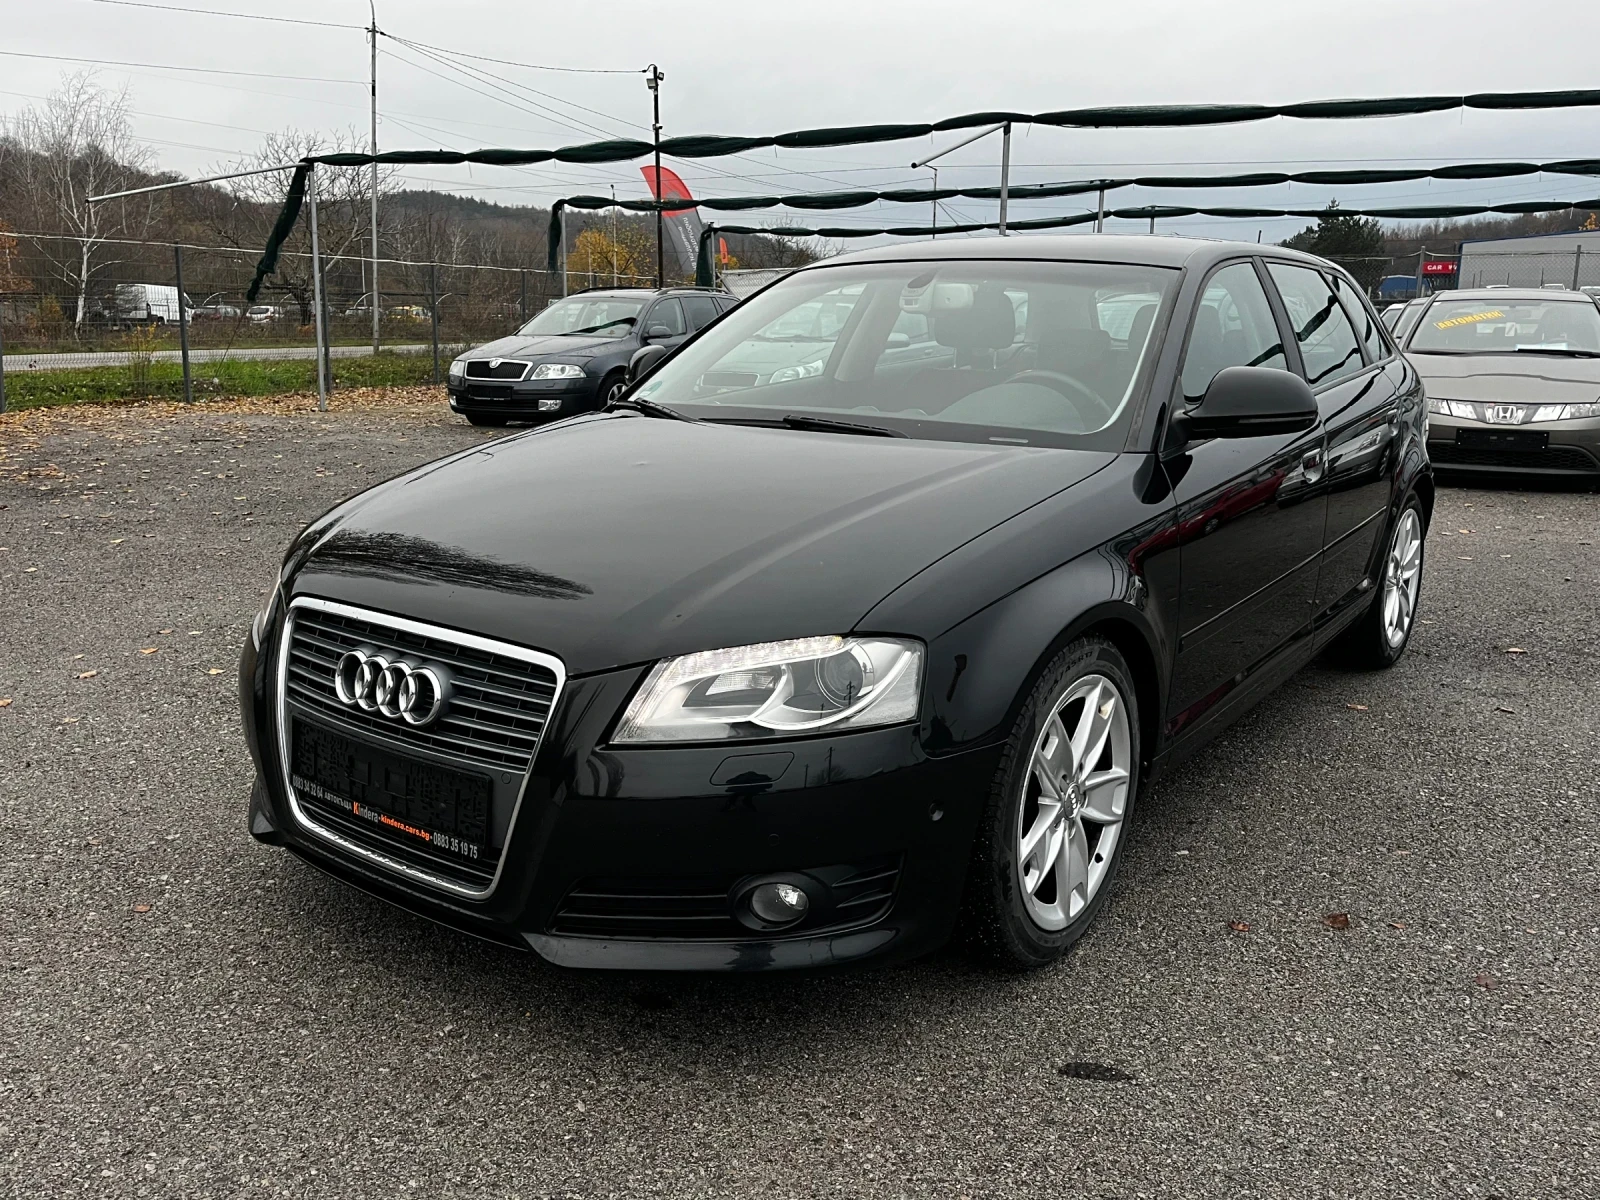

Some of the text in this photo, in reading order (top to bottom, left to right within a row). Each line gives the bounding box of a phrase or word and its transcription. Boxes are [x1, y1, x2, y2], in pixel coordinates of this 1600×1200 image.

[353, 801, 378, 822] Kindera
[433, 832, 449, 849] 0883
[450, 838, 459, 852] 35
[460, 841, 468, 856] 19
[469, 844, 478, 859] 75
